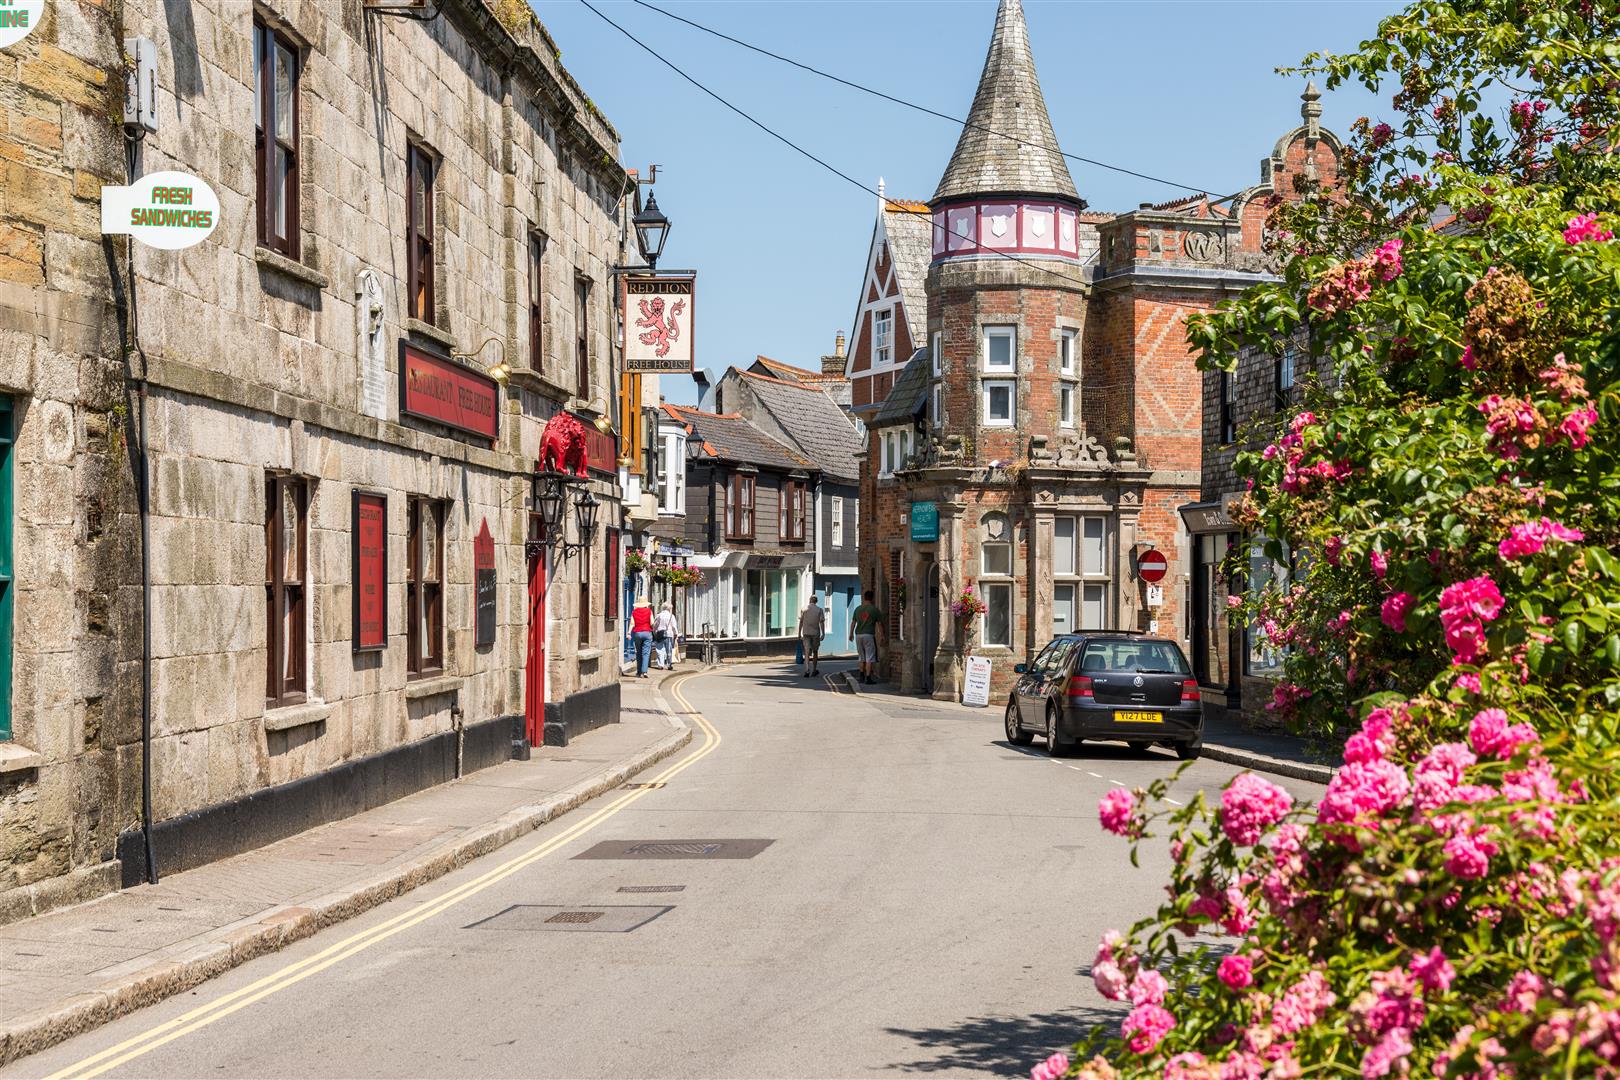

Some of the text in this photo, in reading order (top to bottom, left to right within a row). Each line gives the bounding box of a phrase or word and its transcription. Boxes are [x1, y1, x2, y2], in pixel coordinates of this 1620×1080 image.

[151, 186, 193, 205] FRESH
[130, 207, 213, 229] SANDWICHES
[629, 283, 689, 294] RED LION
[627, 360, 689, 369] FREE HOUSE
[458, 385, 473, 411] FREE
[1120, 712, 1158, 721] Y127 LDE
